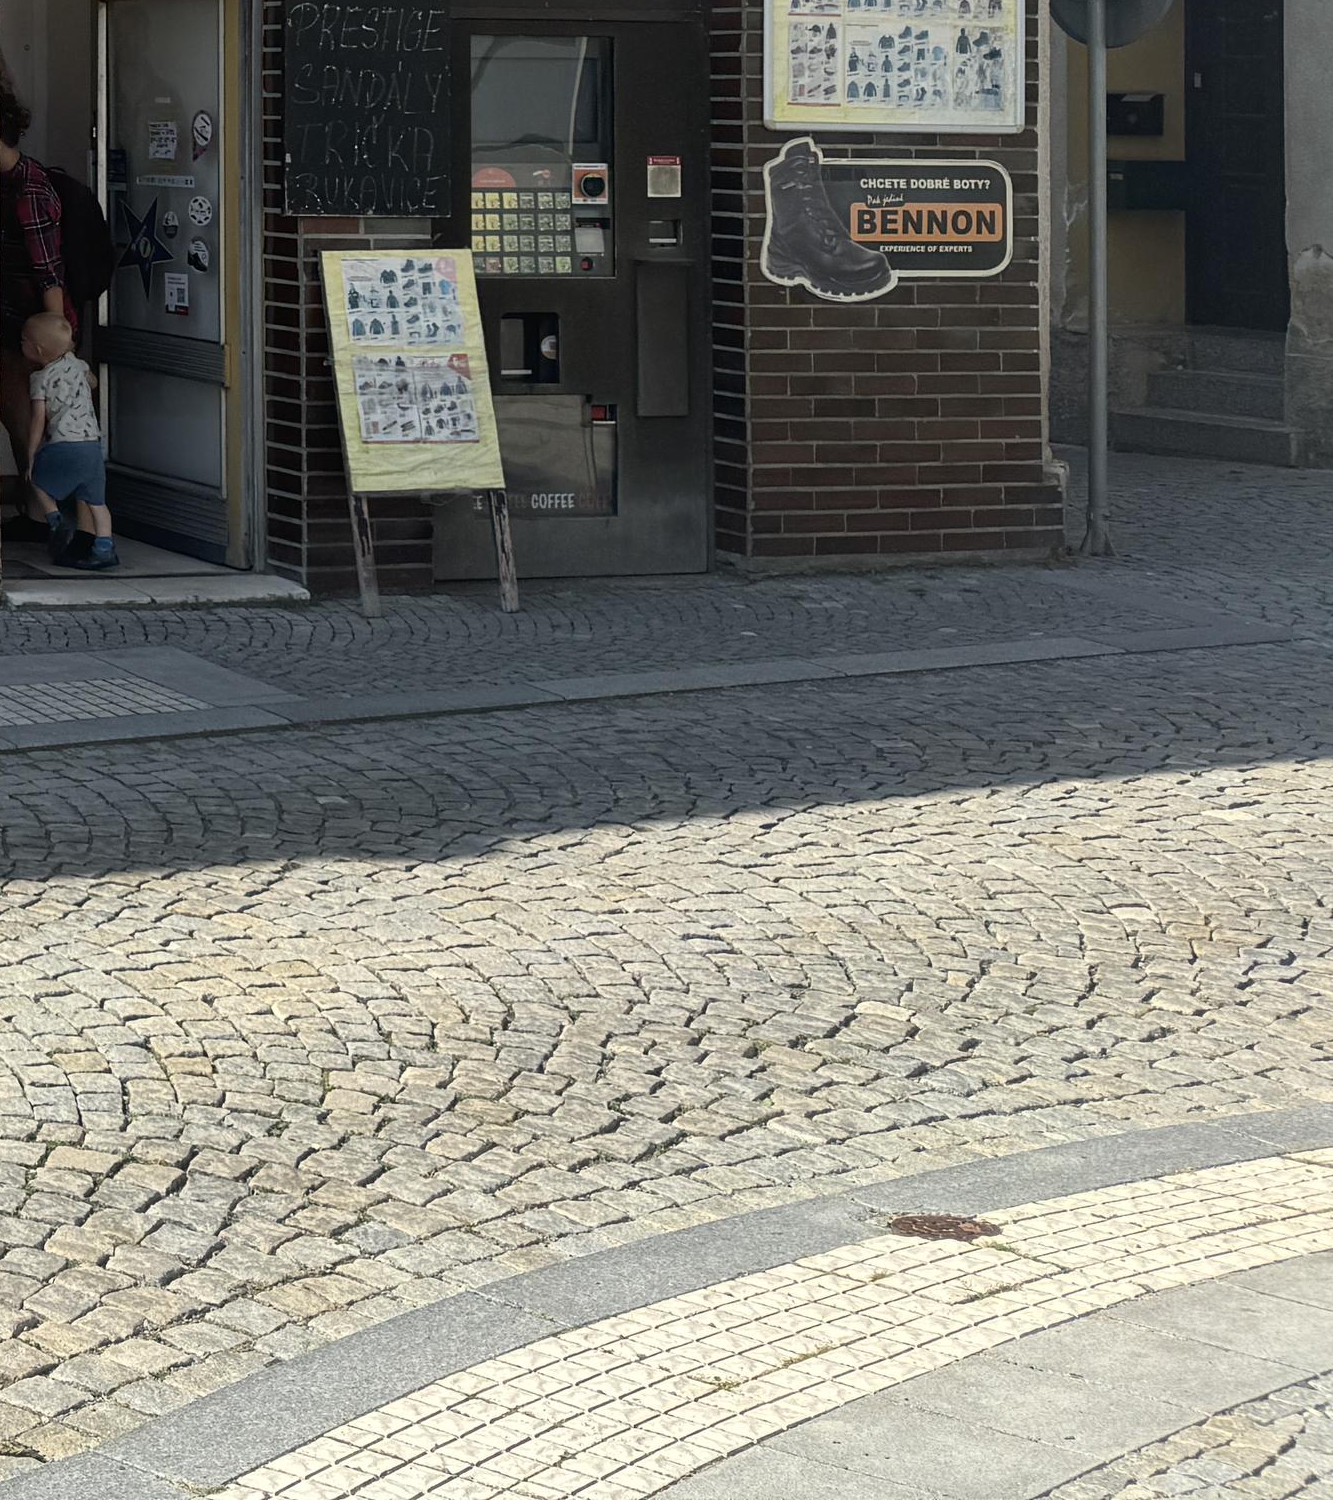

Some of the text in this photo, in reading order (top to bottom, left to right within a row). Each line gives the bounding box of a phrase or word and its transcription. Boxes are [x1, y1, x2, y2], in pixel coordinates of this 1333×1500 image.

[287, 1, 446, 52] PRESTIGE
[860, 176, 991, 190] CHCETE DOBRÉ BOTY?
[857, 209, 996, 235] BENNON
[880, 245, 973, 253] EXPERIENCE OF EXPERTS
[531, 493, 575, 509] COFFEE
